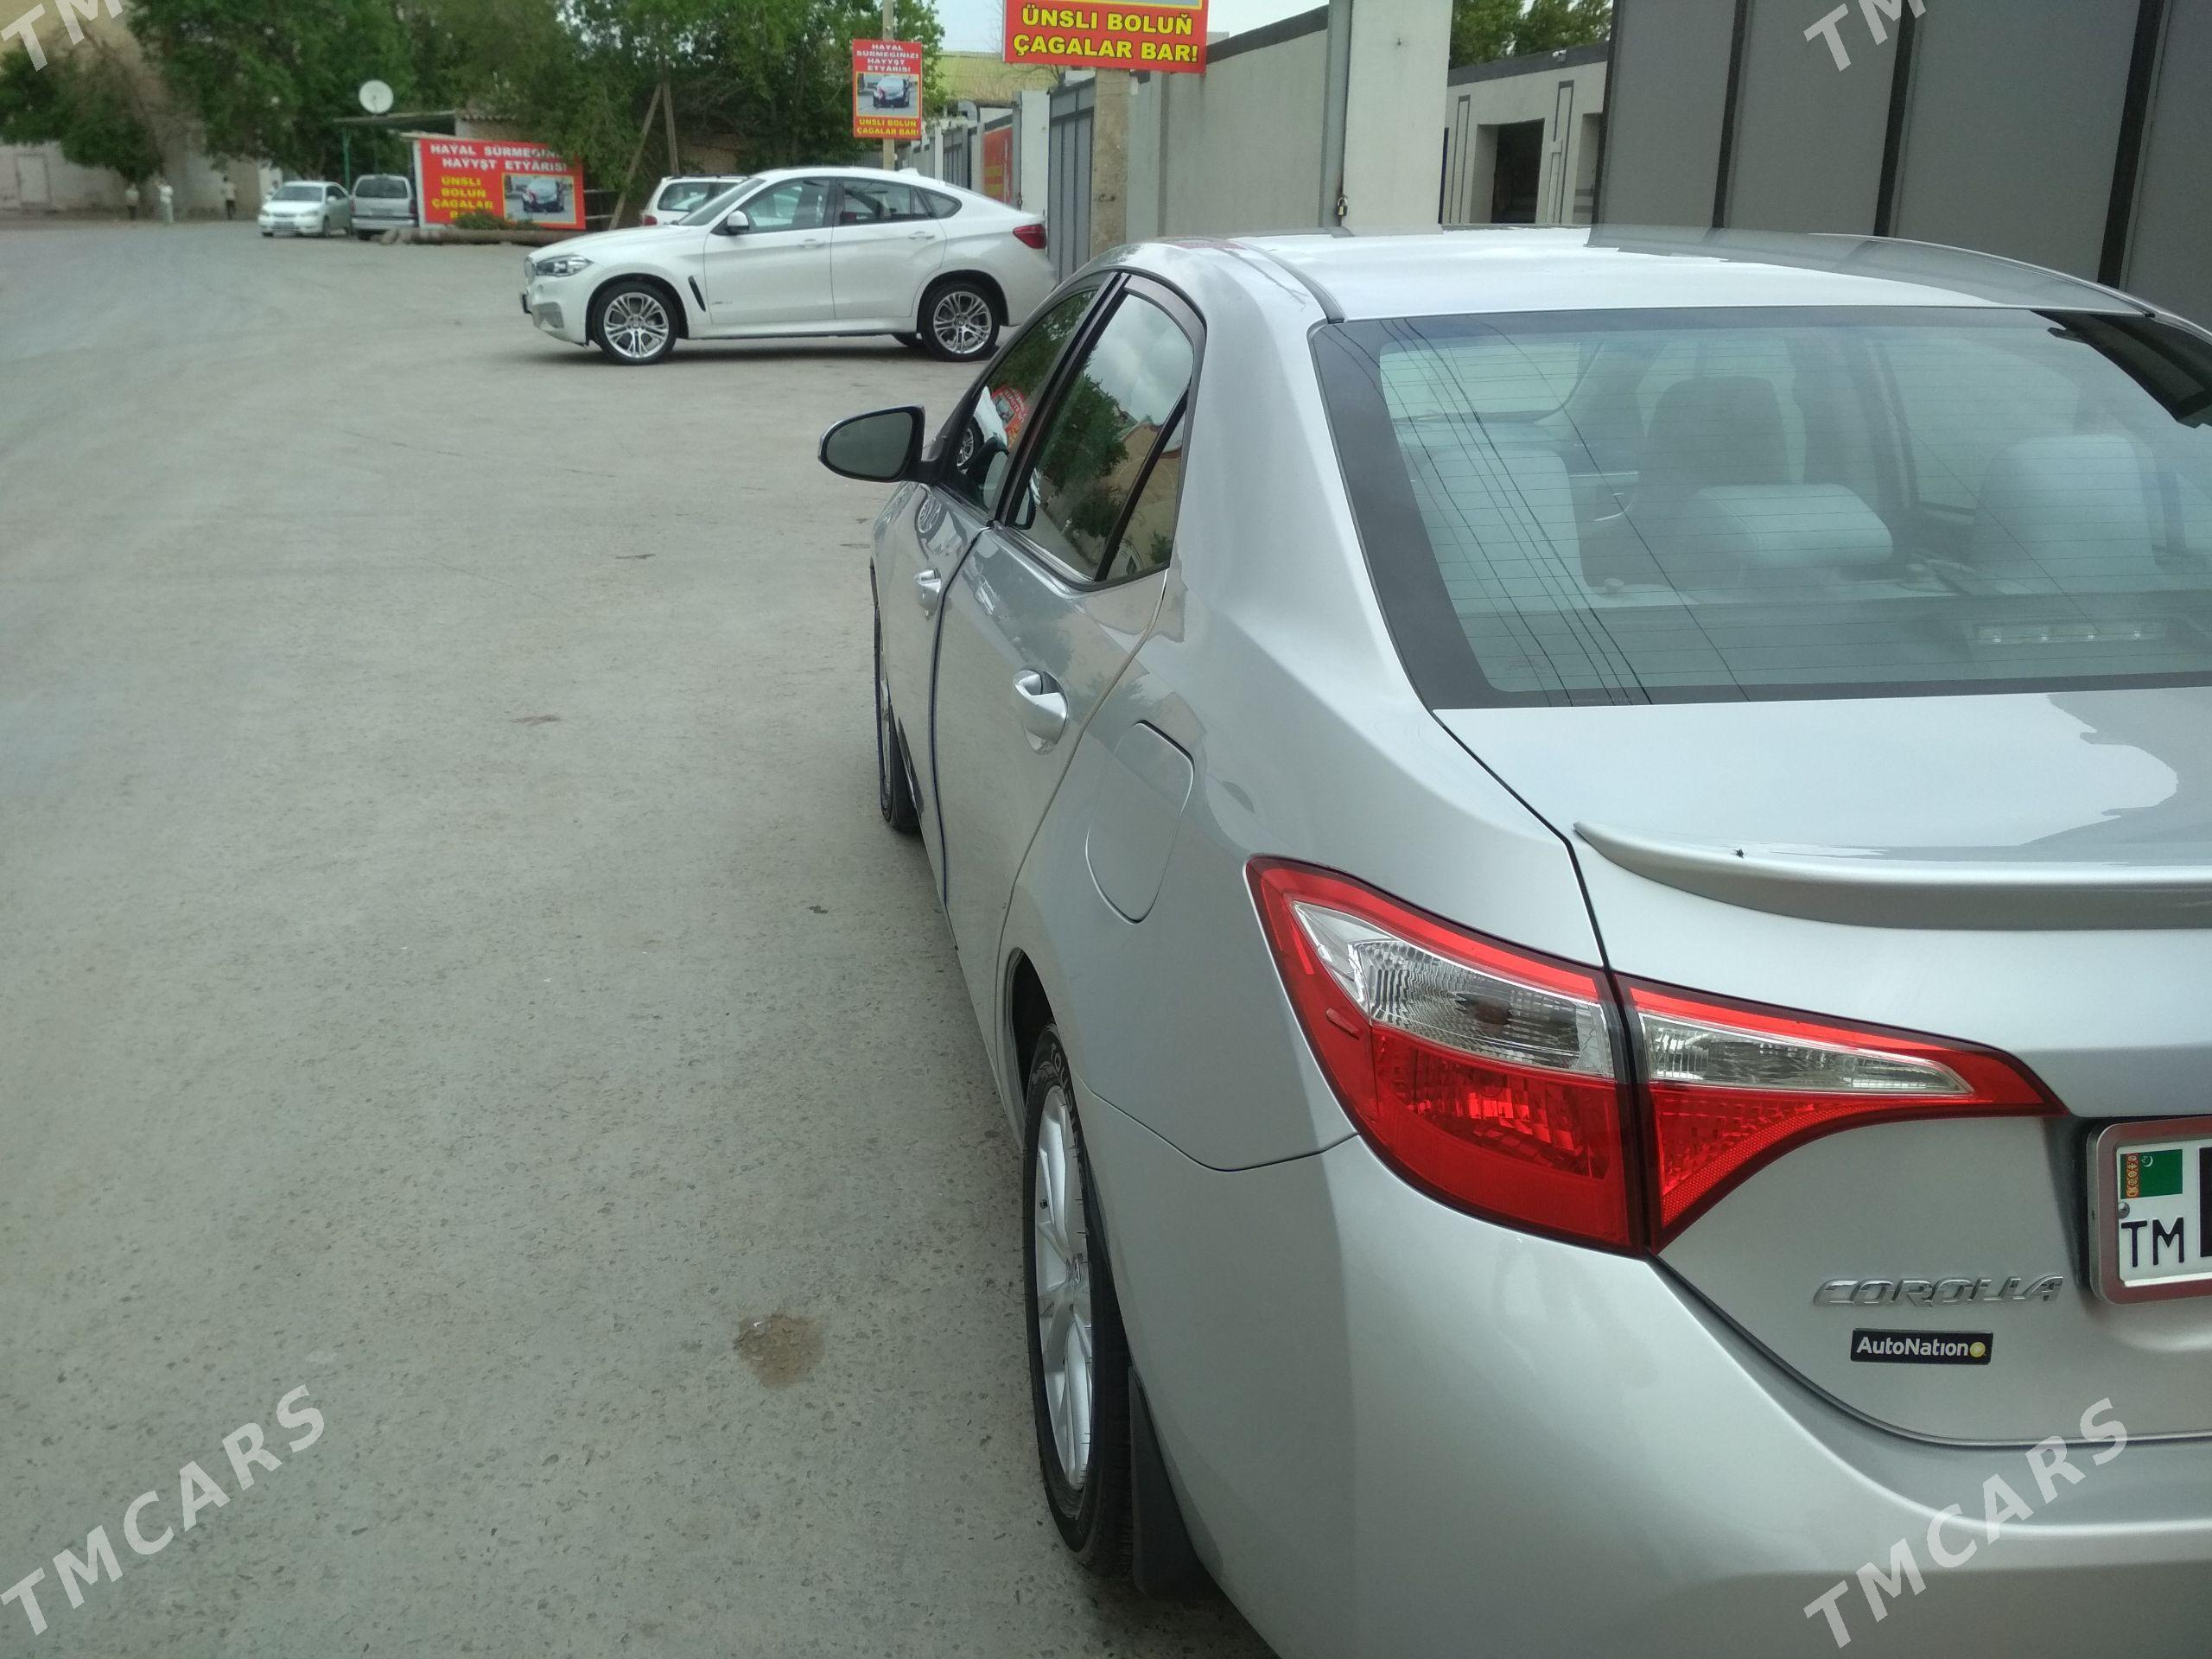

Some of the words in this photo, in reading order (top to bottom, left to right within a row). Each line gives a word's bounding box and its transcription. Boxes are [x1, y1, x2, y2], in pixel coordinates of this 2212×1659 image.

[1022, 4, 1098, 29] ÜNSLI
[1106, 13, 1192, 35] BOLUŇ
[1014, 34, 1133, 59] ÇAGALAR
[1141, 41, 1199, 62] BAR!
[2120, 1217, 2185, 1268] TM
[1813, 1274, 2065, 1307] COROLLA
[1856, 1337, 1969, 1357] AutoNation
